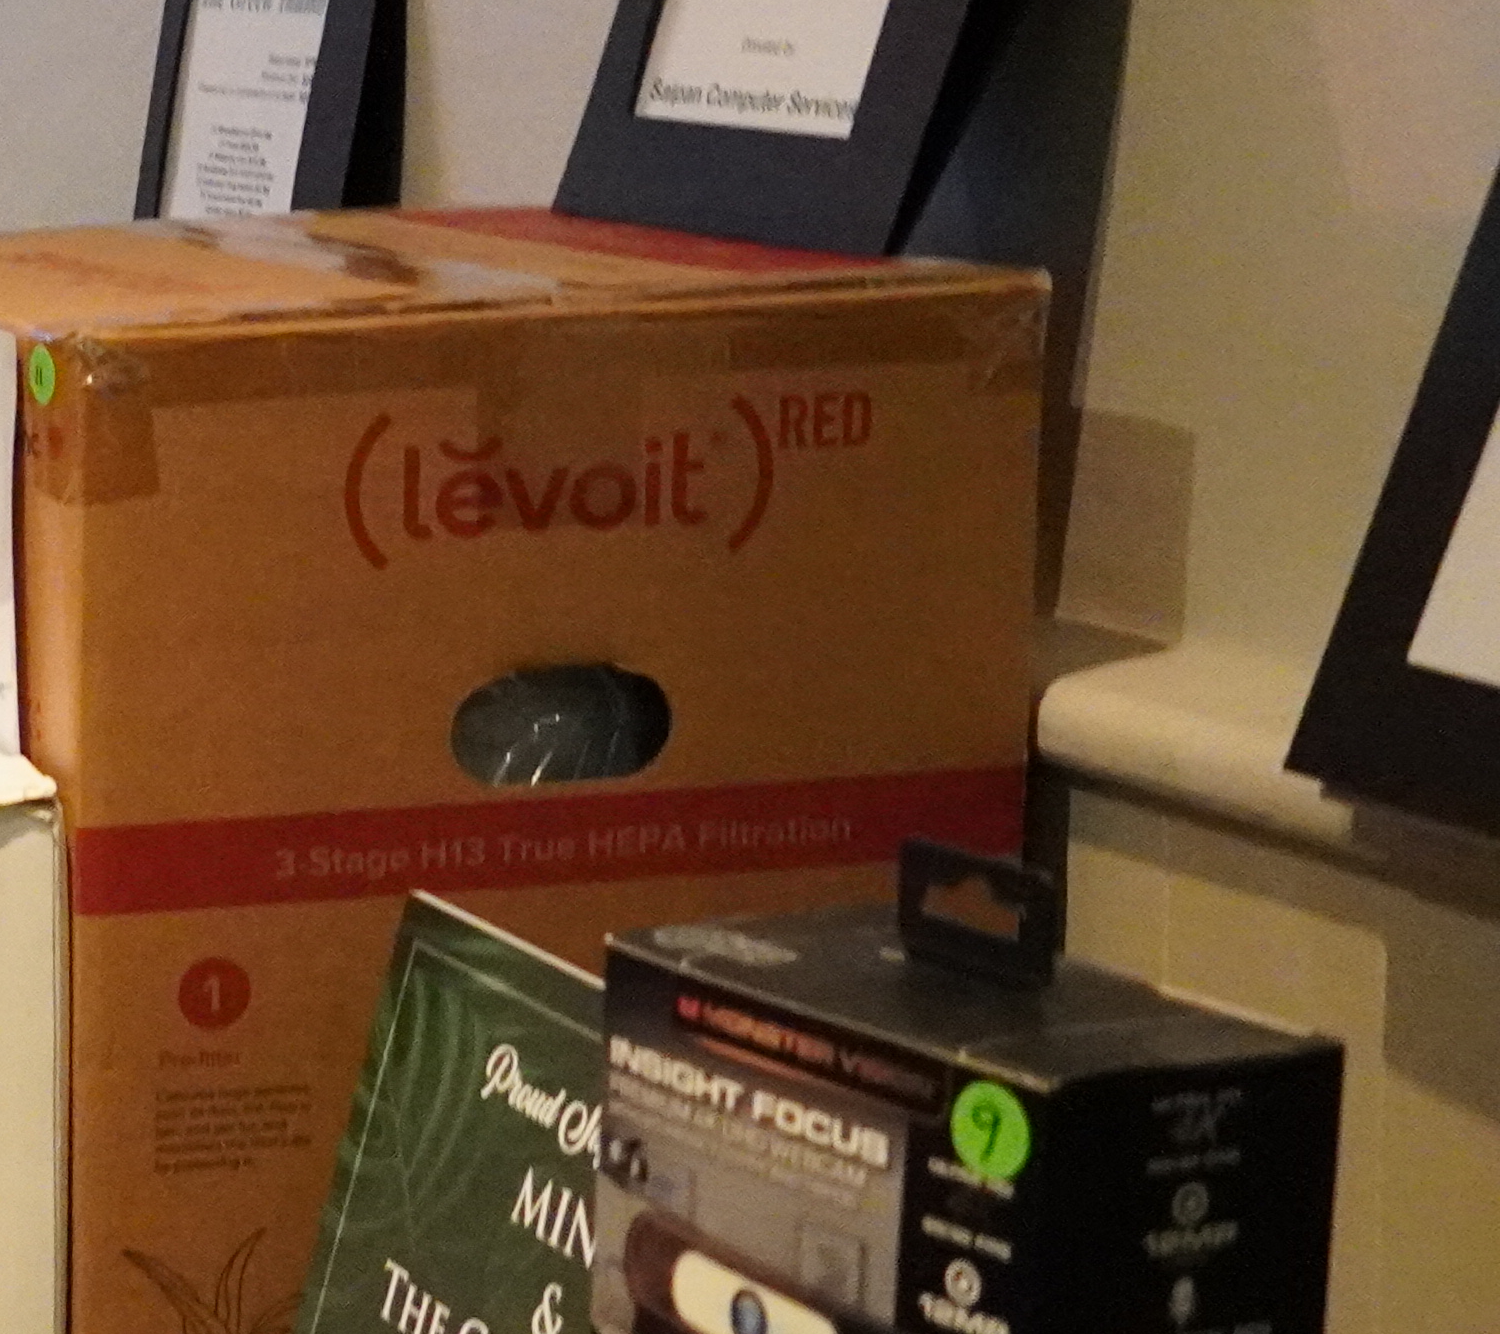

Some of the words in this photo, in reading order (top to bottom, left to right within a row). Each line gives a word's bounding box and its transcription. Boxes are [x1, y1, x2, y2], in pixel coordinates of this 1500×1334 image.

[706, 82, 786, 114] Computer
[777, 391, 873, 453] RED
[421, 836, 487, 871] H13
[500, 830, 575, 867] True
[588, 822, 687, 859] HEPA
[698, 814, 854, 852] Filtration
[202, 973, 221, 1012] 1
[481, 1043, 568, 1129] Proud
[751, 1088, 892, 1168] FOCUS
[971, 1097, 1002, 1165] 9
